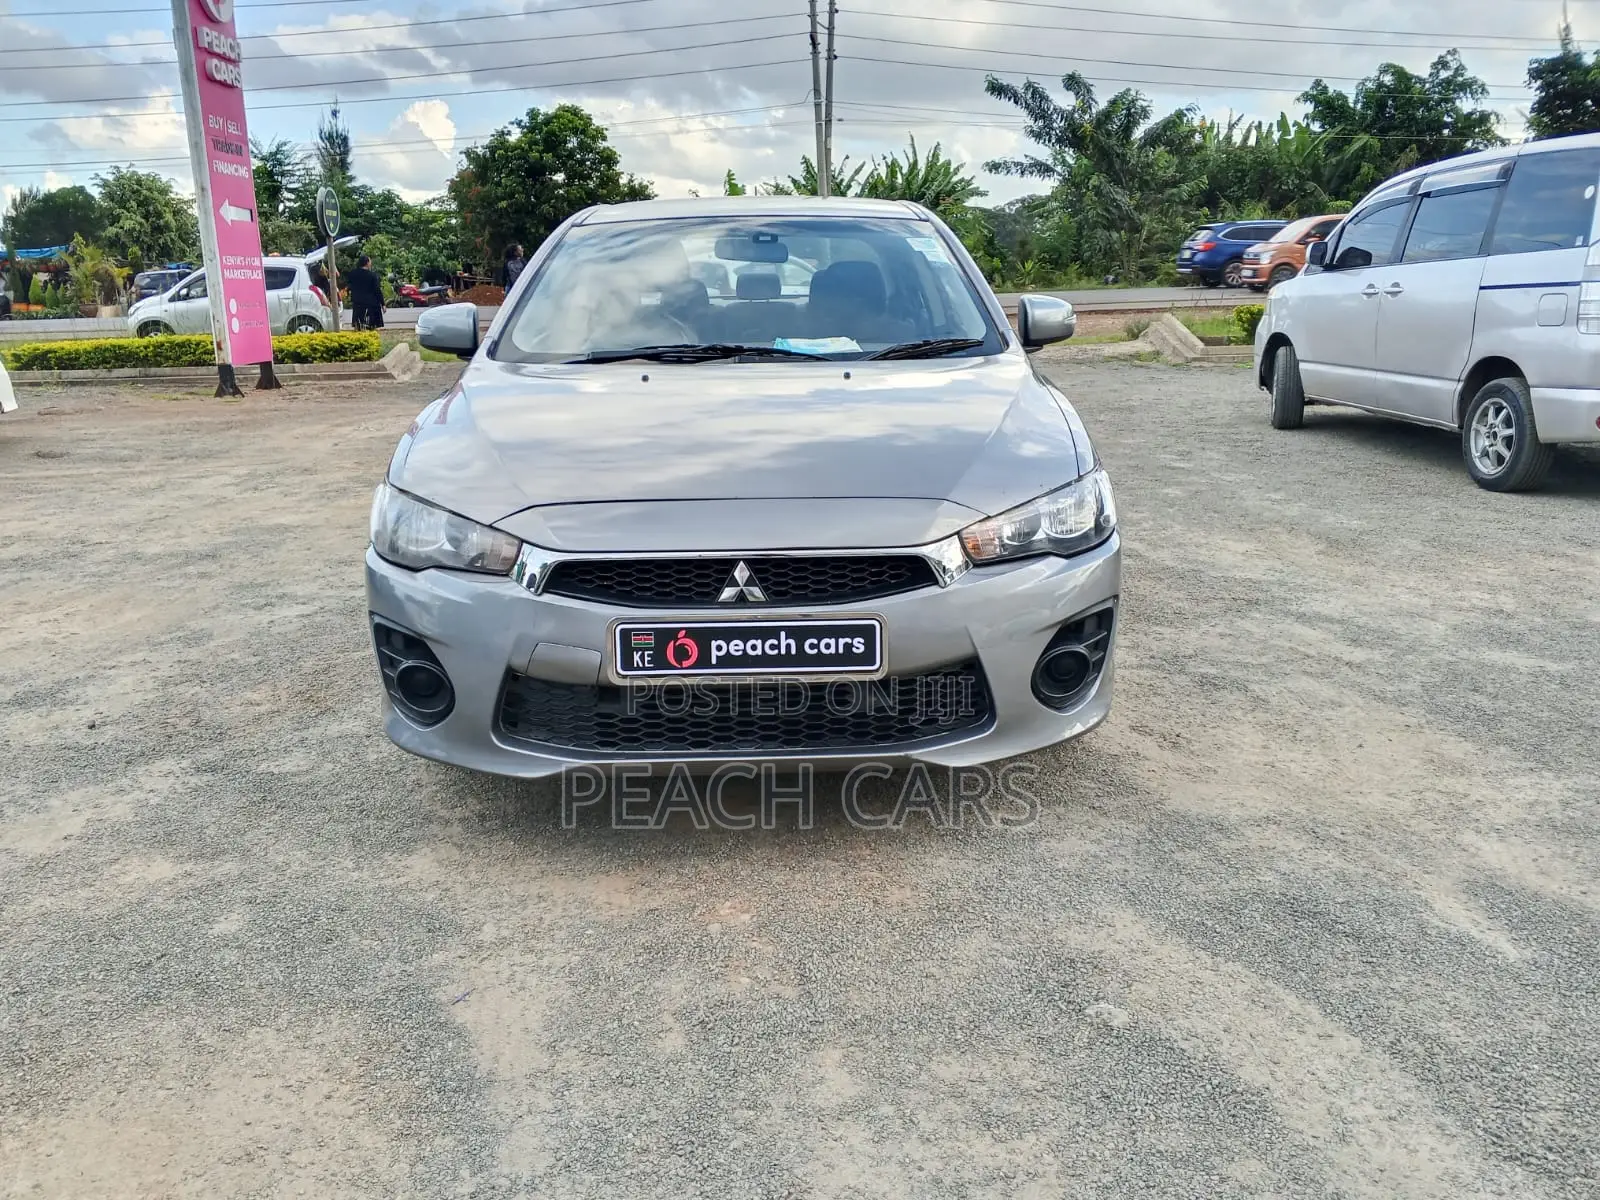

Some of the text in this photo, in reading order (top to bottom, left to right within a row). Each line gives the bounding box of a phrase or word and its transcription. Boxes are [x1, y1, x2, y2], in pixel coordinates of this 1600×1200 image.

[199, 27, 242, 61] PEACH
[206, 58, 242, 88] CARS
[208, 114, 242, 135] BUY SELL
[212, 159, 249, 178] FINANCING
[223, 268, 263, 280] MARKETPLACE
[710, 631, 865, 664] peach cars
[633, 651, 654, 667] KE
